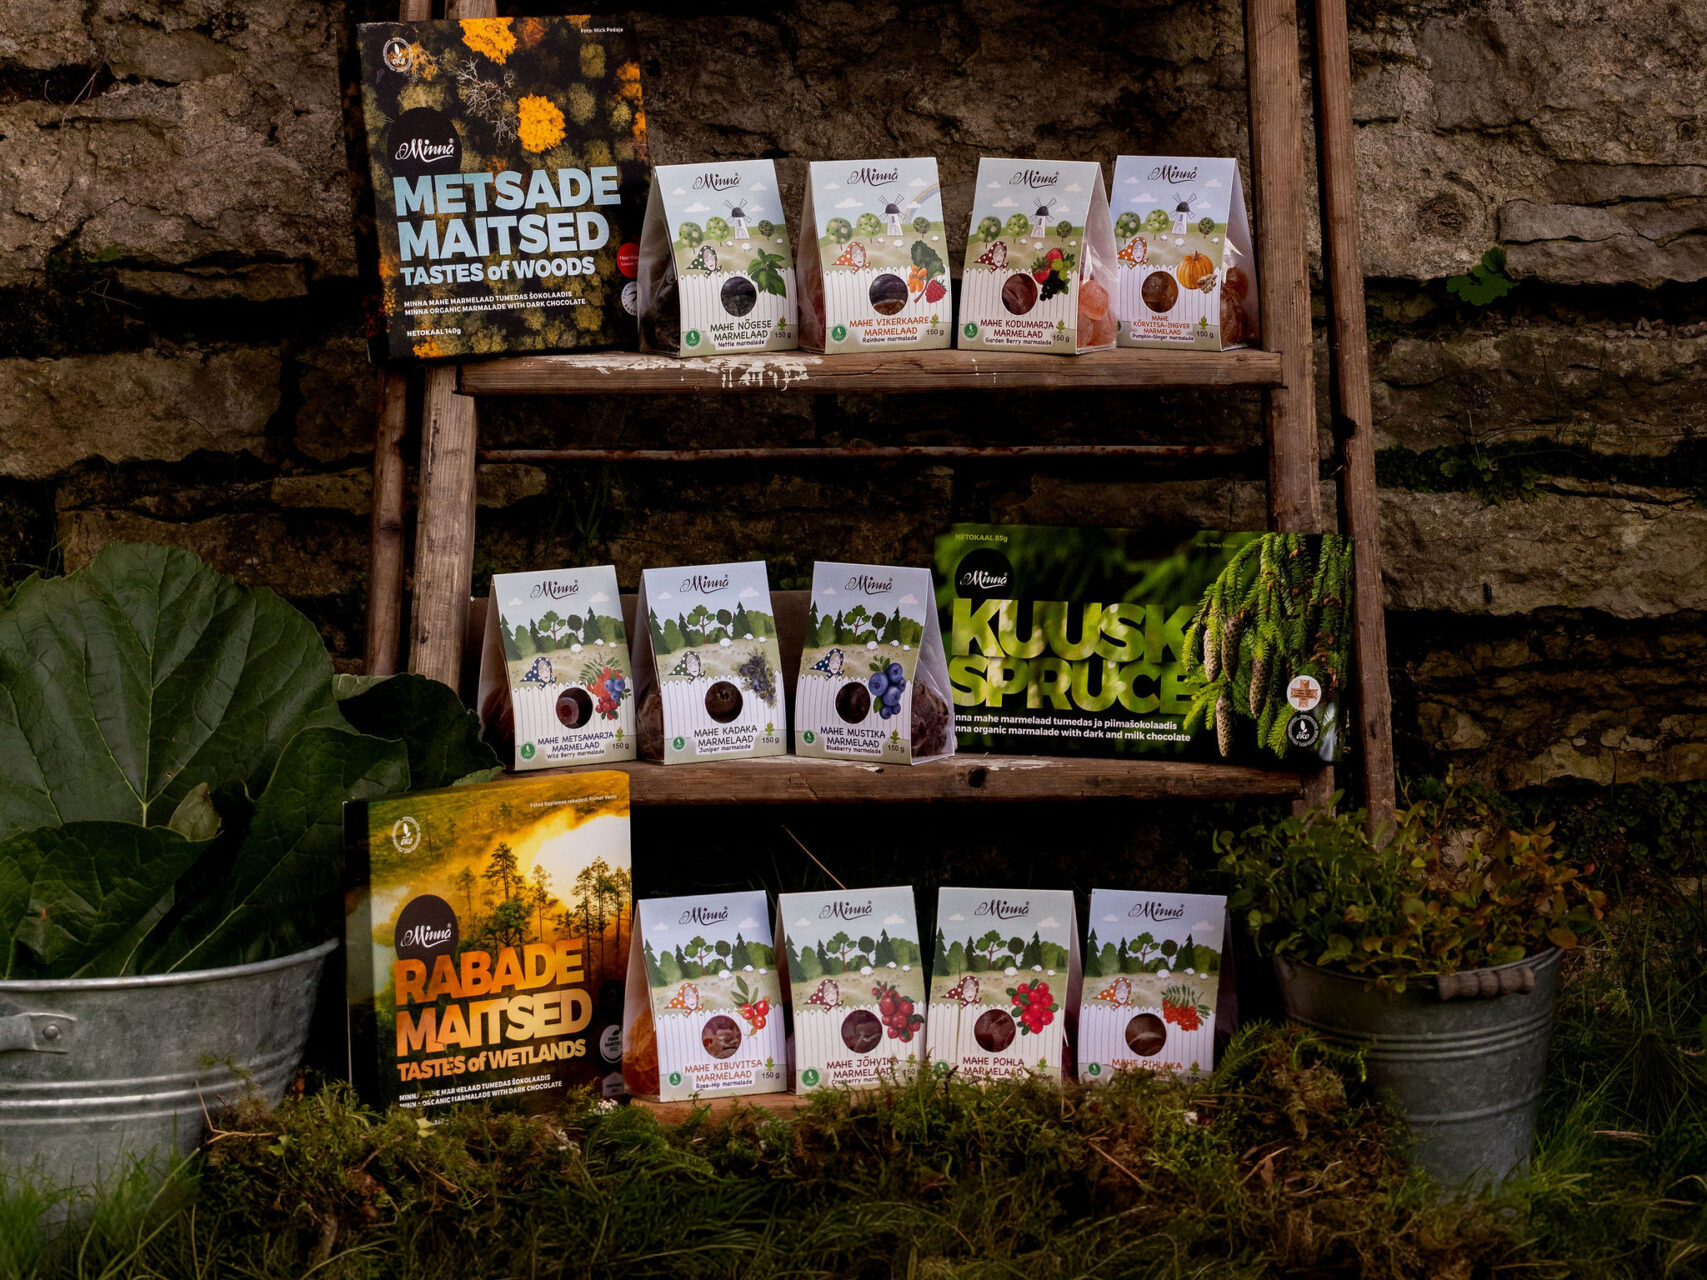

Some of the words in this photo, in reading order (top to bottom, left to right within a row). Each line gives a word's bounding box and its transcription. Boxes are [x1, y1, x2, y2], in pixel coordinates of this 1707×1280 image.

[394, 137, 454, 162] Minna
[392, 166, 622, 217] METSADE
[397, 211, 610, 261] MAITSED
[399, 263, 484, 286] TASTES
[487, 260, 510, 280] of
[511, 256, 596, 280] WOODS
[404, 300, 428, 308] MINNA
[450, 296, 495, 305] MARMELAAD
[495, 294, 528, 302] TUMEDAS
[529, 291, 573, 300] ŠOKOLAADIS
[429, 306, 461, 315] ORGANIC
[462, 304, 506, 313] MARMALADE
[507, 302, 525, 310] WITH
[526, 301, 545, 309] DARK
[546, 298, 586, 308] CHOCOLATE
[710, 323, 735, 332] MAHE
[737, 319, 772, 330] NÕGESE
[849, 319, 874, 327] MAHE
[875, 316, 930, 326] VIKERKAARE
[980, 319, 1003, 327] MAHE
[1005, 320, 1054, 329] KODUMARJA
[407, 329, 445, 337] NETOKAAL
[713, 331, 768, 341] MARMELAAD
[864, 327, 918, 336] MARMELAAD
[993, 329, 1043, 338] MARMELAAD
[955, 533, 994, 541] NETOKAAL
[960, 569, 1008, 588] Minna
[951, 598, 1200, 663] KUUSK
[949, 654, 1198, 715] SPRUCE
[974, 714, 999, 722] mahe
[1000, 716, 1052, 724] marmelaad
[1053, 717, 1093, 726] tumedas
[1104, 718, 1177, 730] piimašokolaadis
[694, 728, 719, 737] MAHE
[722, 724, 758, 734] KADAKA
[820, 726, 844, 736] MAHE
[847, 729, 886, 739] MUSTIKA
[973, 726, 1007, 735] organic
[1008, 726, 1060, 736] marmalade
[1061, 728, 1082, 737] with
[1083, 729, 1104, 738] dark
[1105, 730, 1123, 739] and
[1124, 731, 1145, 740] milk
[1146, 732, 1191, 742] chocolate
[537, 736, 559, 745] MAHE
[562, 731, 614, 742] METSAMARJA
[697, 734, 754, 747] MARMELAAD
[826, 737, 880, 747] MARMELAAD
[552, 741, 600, 752] MARMELAAD
[400, 923, 452, 948] Minna
[394, 938, 585, 1006] RABADE
[395, 987, 593, 1057] MAITSED
[397, 1055, 465, 1082] TASTES
[467, 1051, 487, 1073] of
[488, 1039, 586, 1070] WETLANDS
[685, 1065, 710, 1074] MAHE
[713, 1060, 763, 1070] KIBUVITSA
[826, 1060, 853, 1069] MAHE
[963, 1057, 989, 1065] MAHE
[993, 1057, 1024, 1066] POHLA
[696, 1071, 752, 1082] MARMELAAD
[833, 1067, 893, 1078] MARMELAAD
[482, 1079, 511, 1090] TUMEDAS
[511, 1074, 551, 1085] ŠOKOLAADIS
[491, 1088, 508, 1098] WITH
[509, 1086, 526, 1095] DARK
[526, 1080, 562, 1092] CHOCOLATE
[695, 1081, 721, 1089] Rose-Hip
